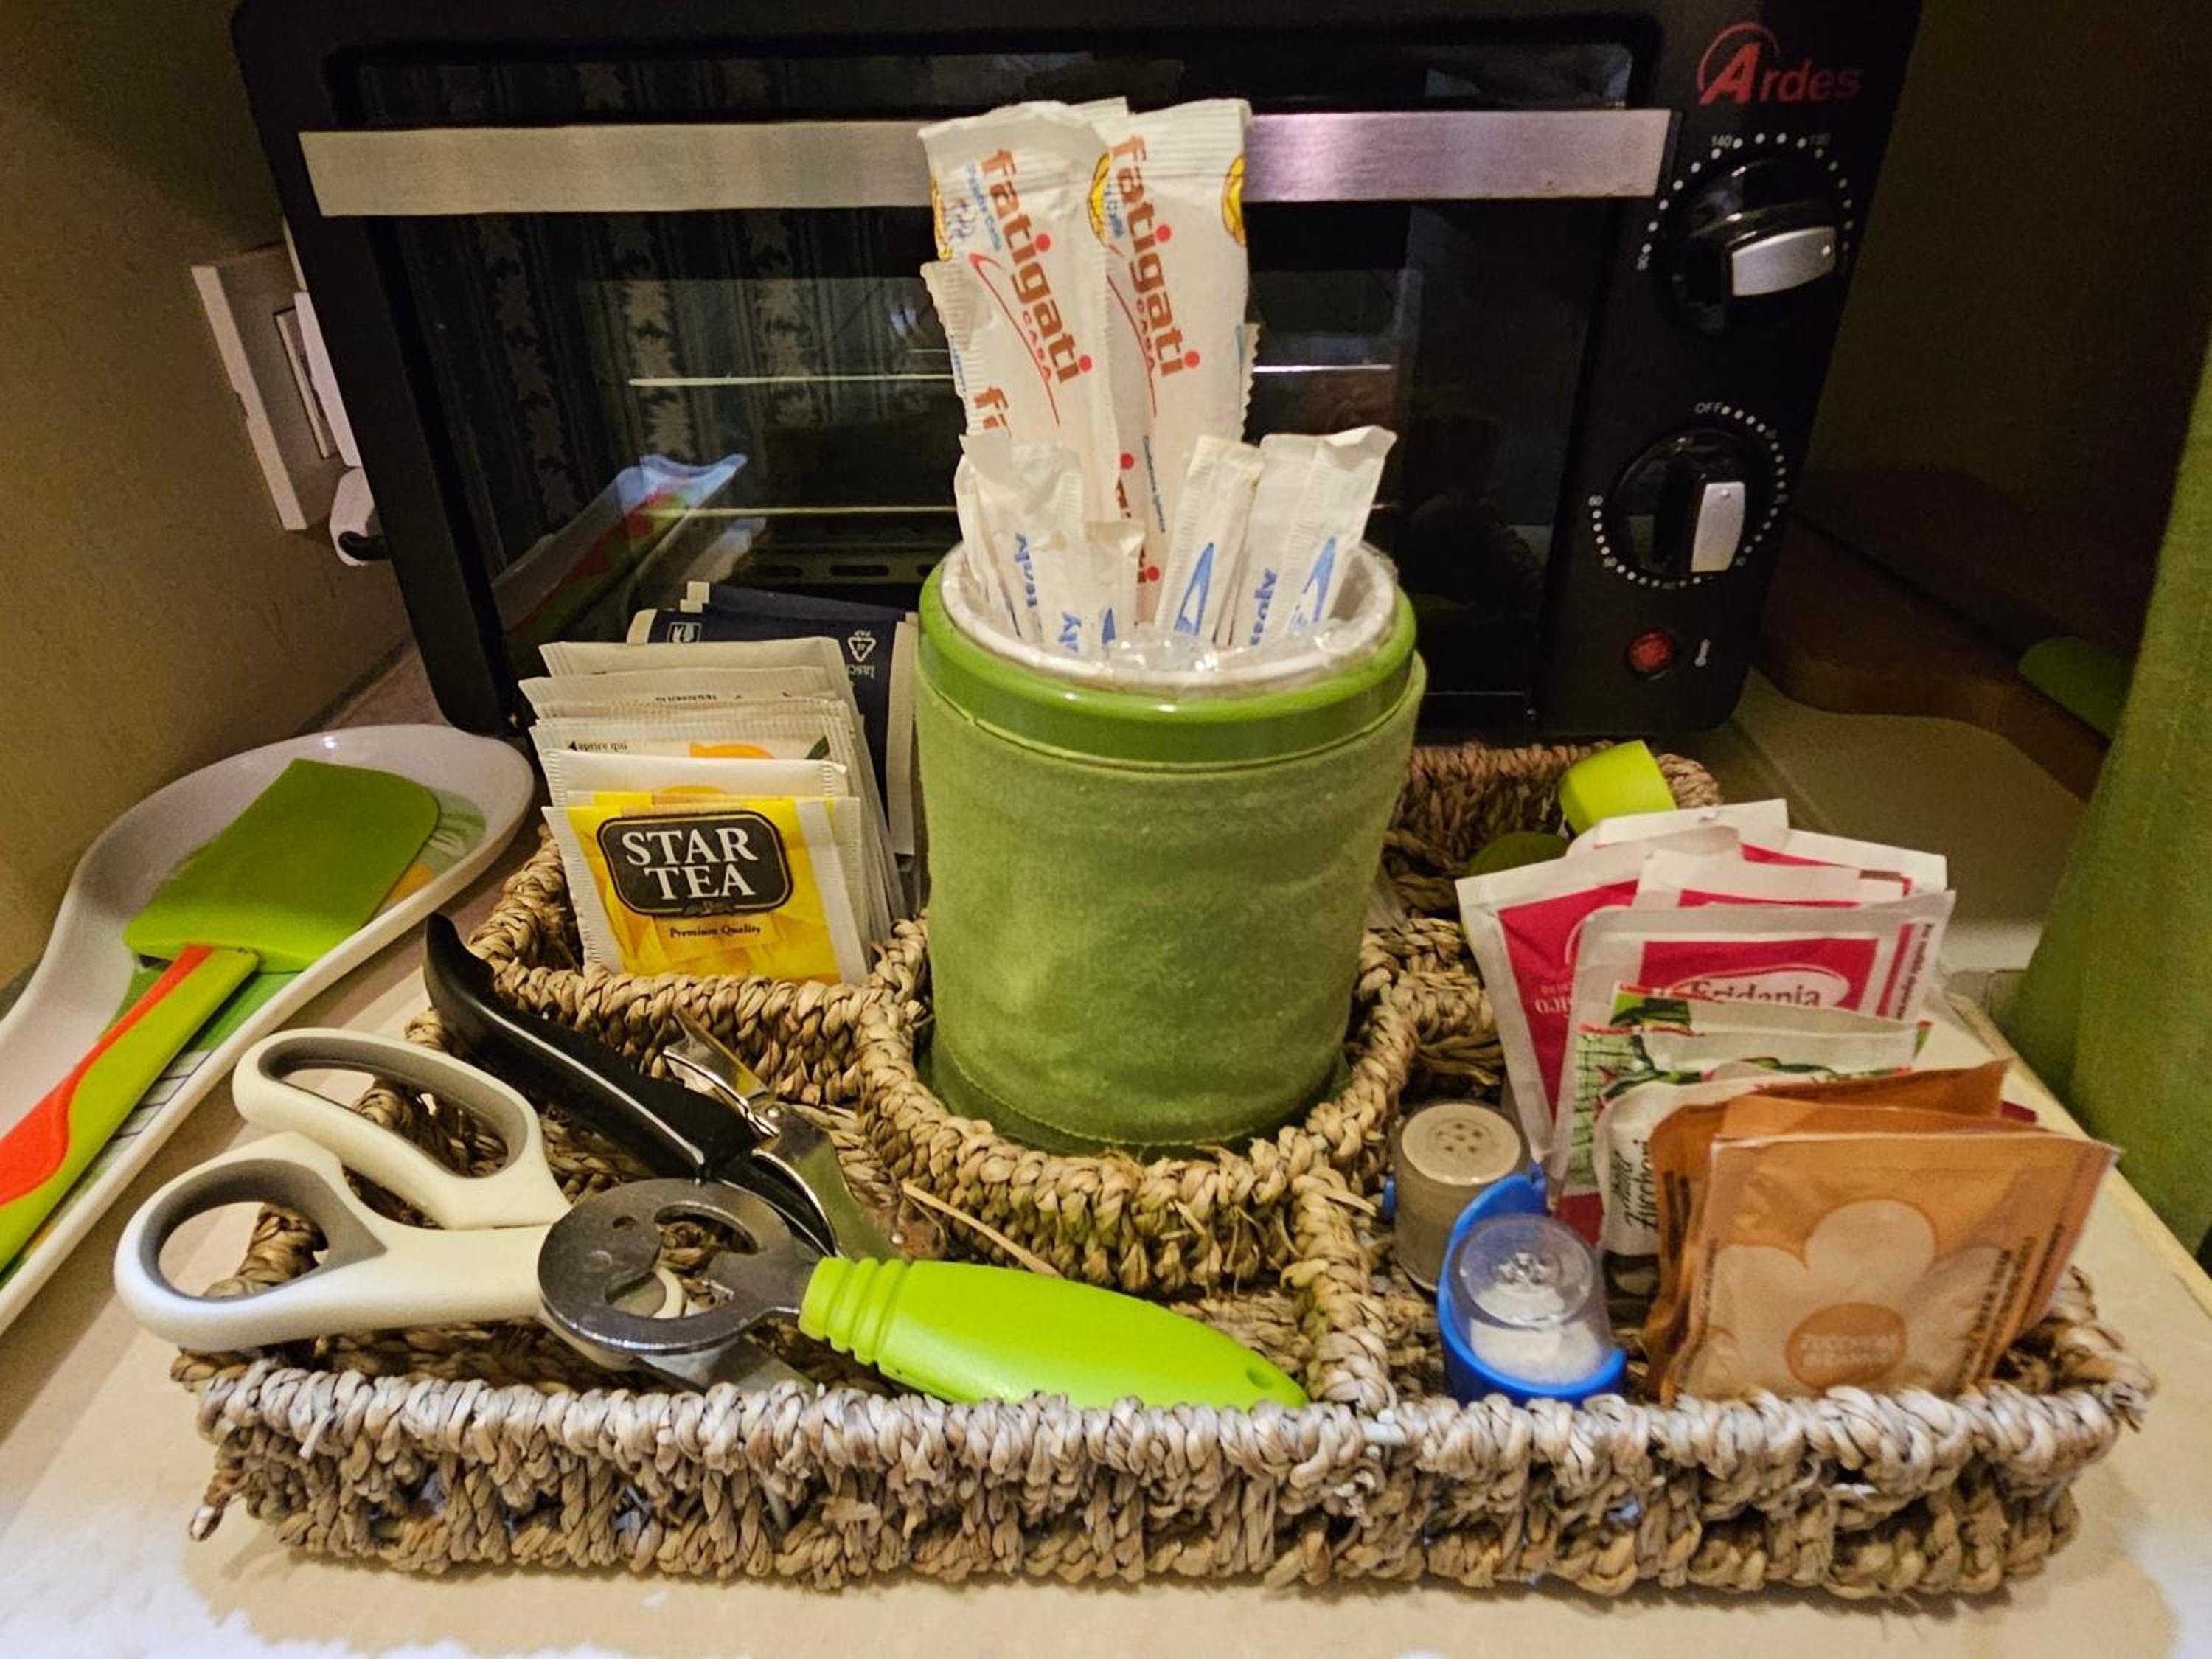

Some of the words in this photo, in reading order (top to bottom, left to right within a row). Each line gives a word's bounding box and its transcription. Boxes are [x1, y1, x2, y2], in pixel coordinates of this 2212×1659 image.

[1698, 41, 1863, 105] Ardes
[981, 148, 1092, 383] fatigati
[1110, 134, 1202, 378] fatigati
[1695, 402, 1722, 414] OFF
[622, 827, 759, 866] STAR
[644, 863, 756, 900] TEA
[669, 927, 719, 939] Premium
[721, 924, 762, 936] Quality
